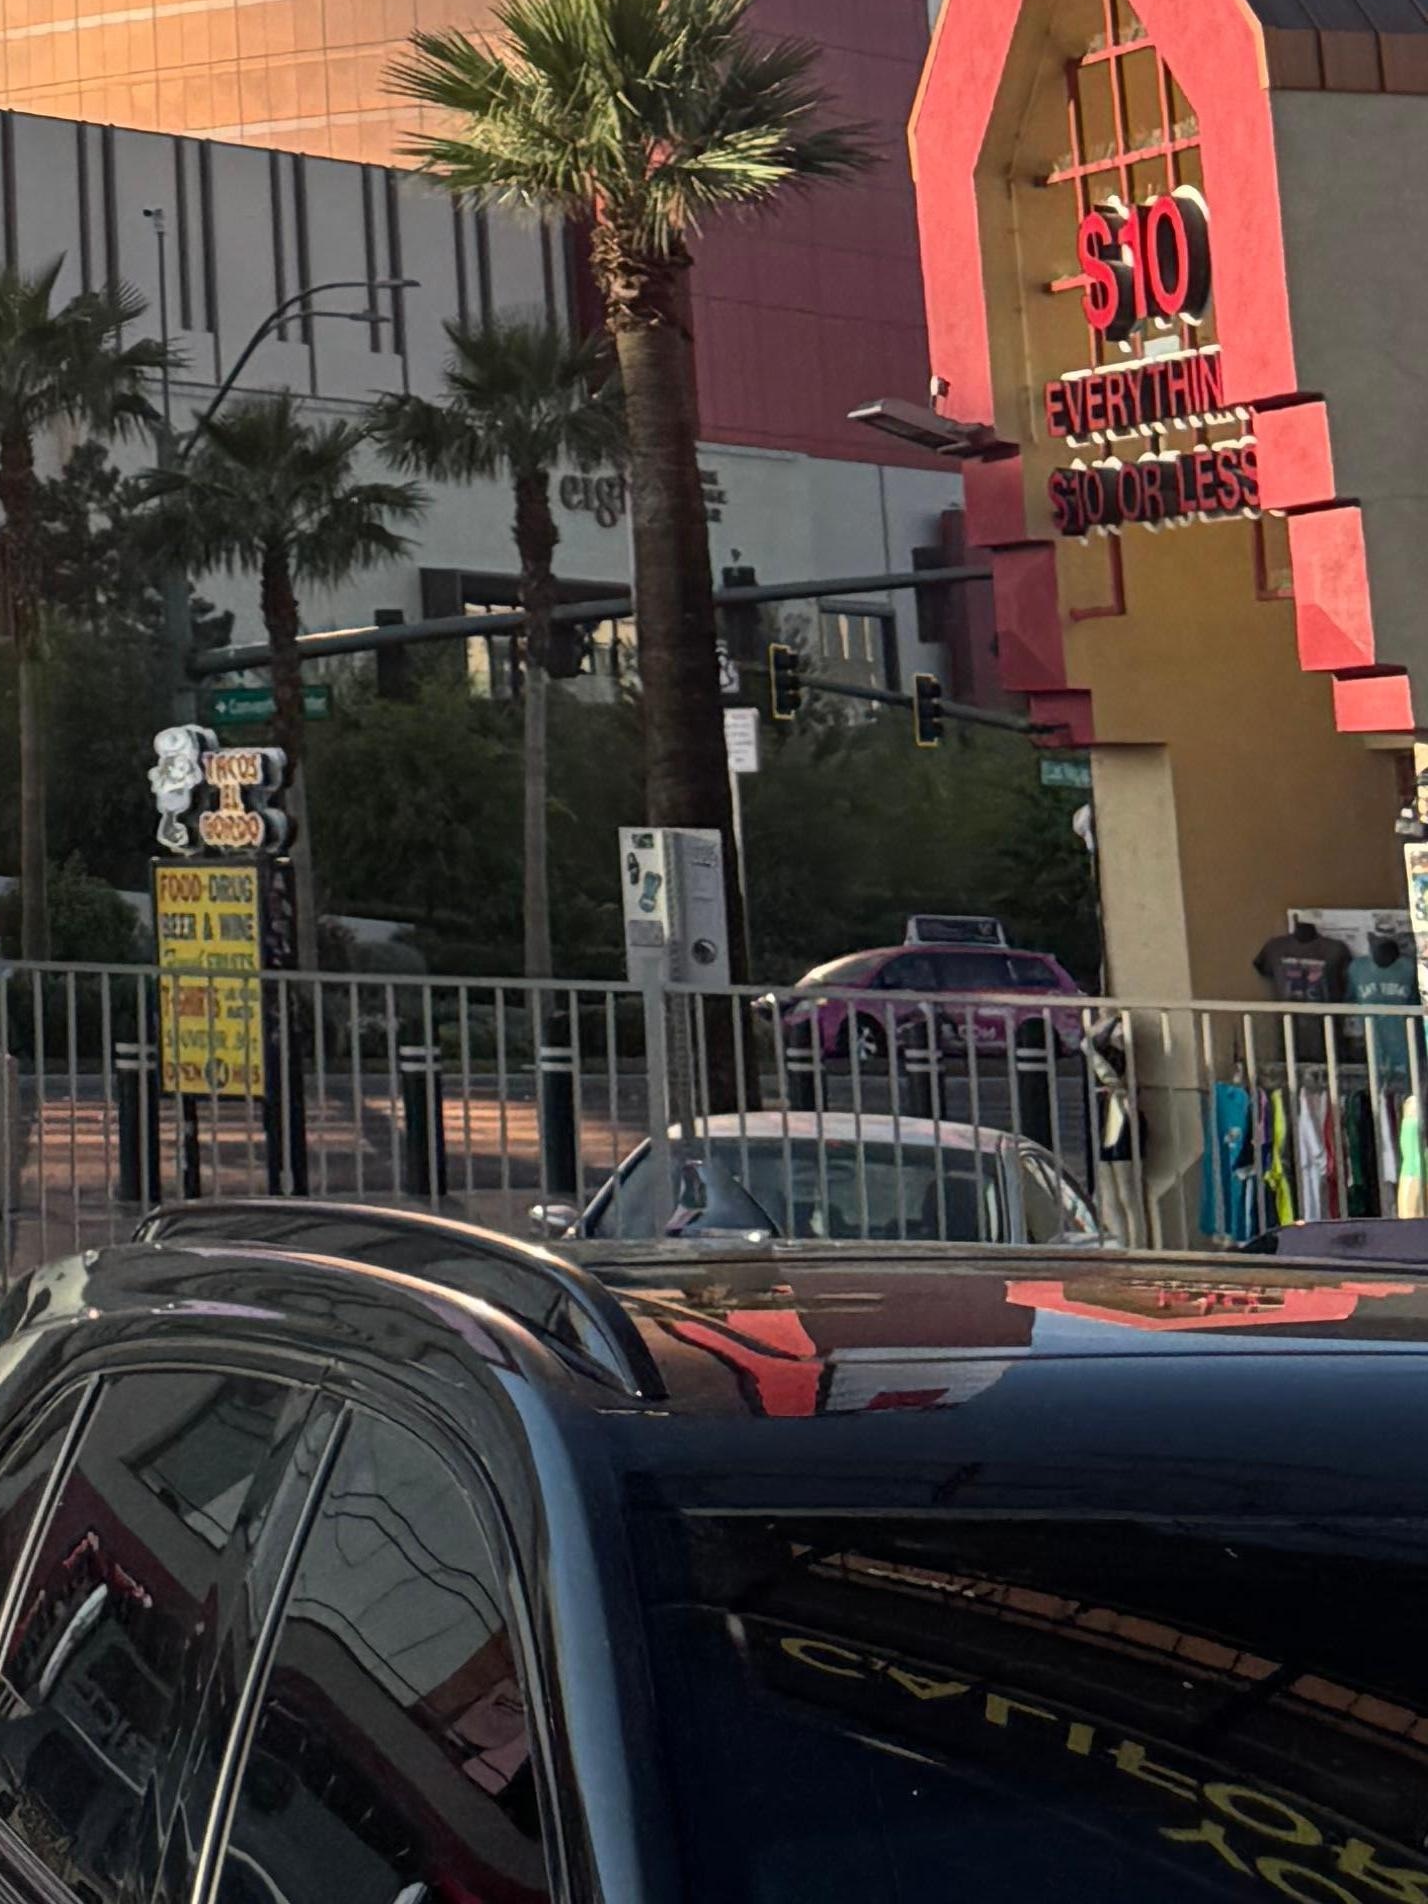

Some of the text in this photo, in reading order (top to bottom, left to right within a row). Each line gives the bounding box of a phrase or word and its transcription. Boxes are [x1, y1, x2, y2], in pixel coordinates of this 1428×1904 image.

[1077, 196, 1190, 330] $10
[1046, 352, 1225, 436] EVERYTHIN
[1119, 463, 1164, 521] OR
[1177, 442, 1261, 513] LESS
[204, 753, 261, 784] TACOS
[200, 813, 263, 844] GORDO
